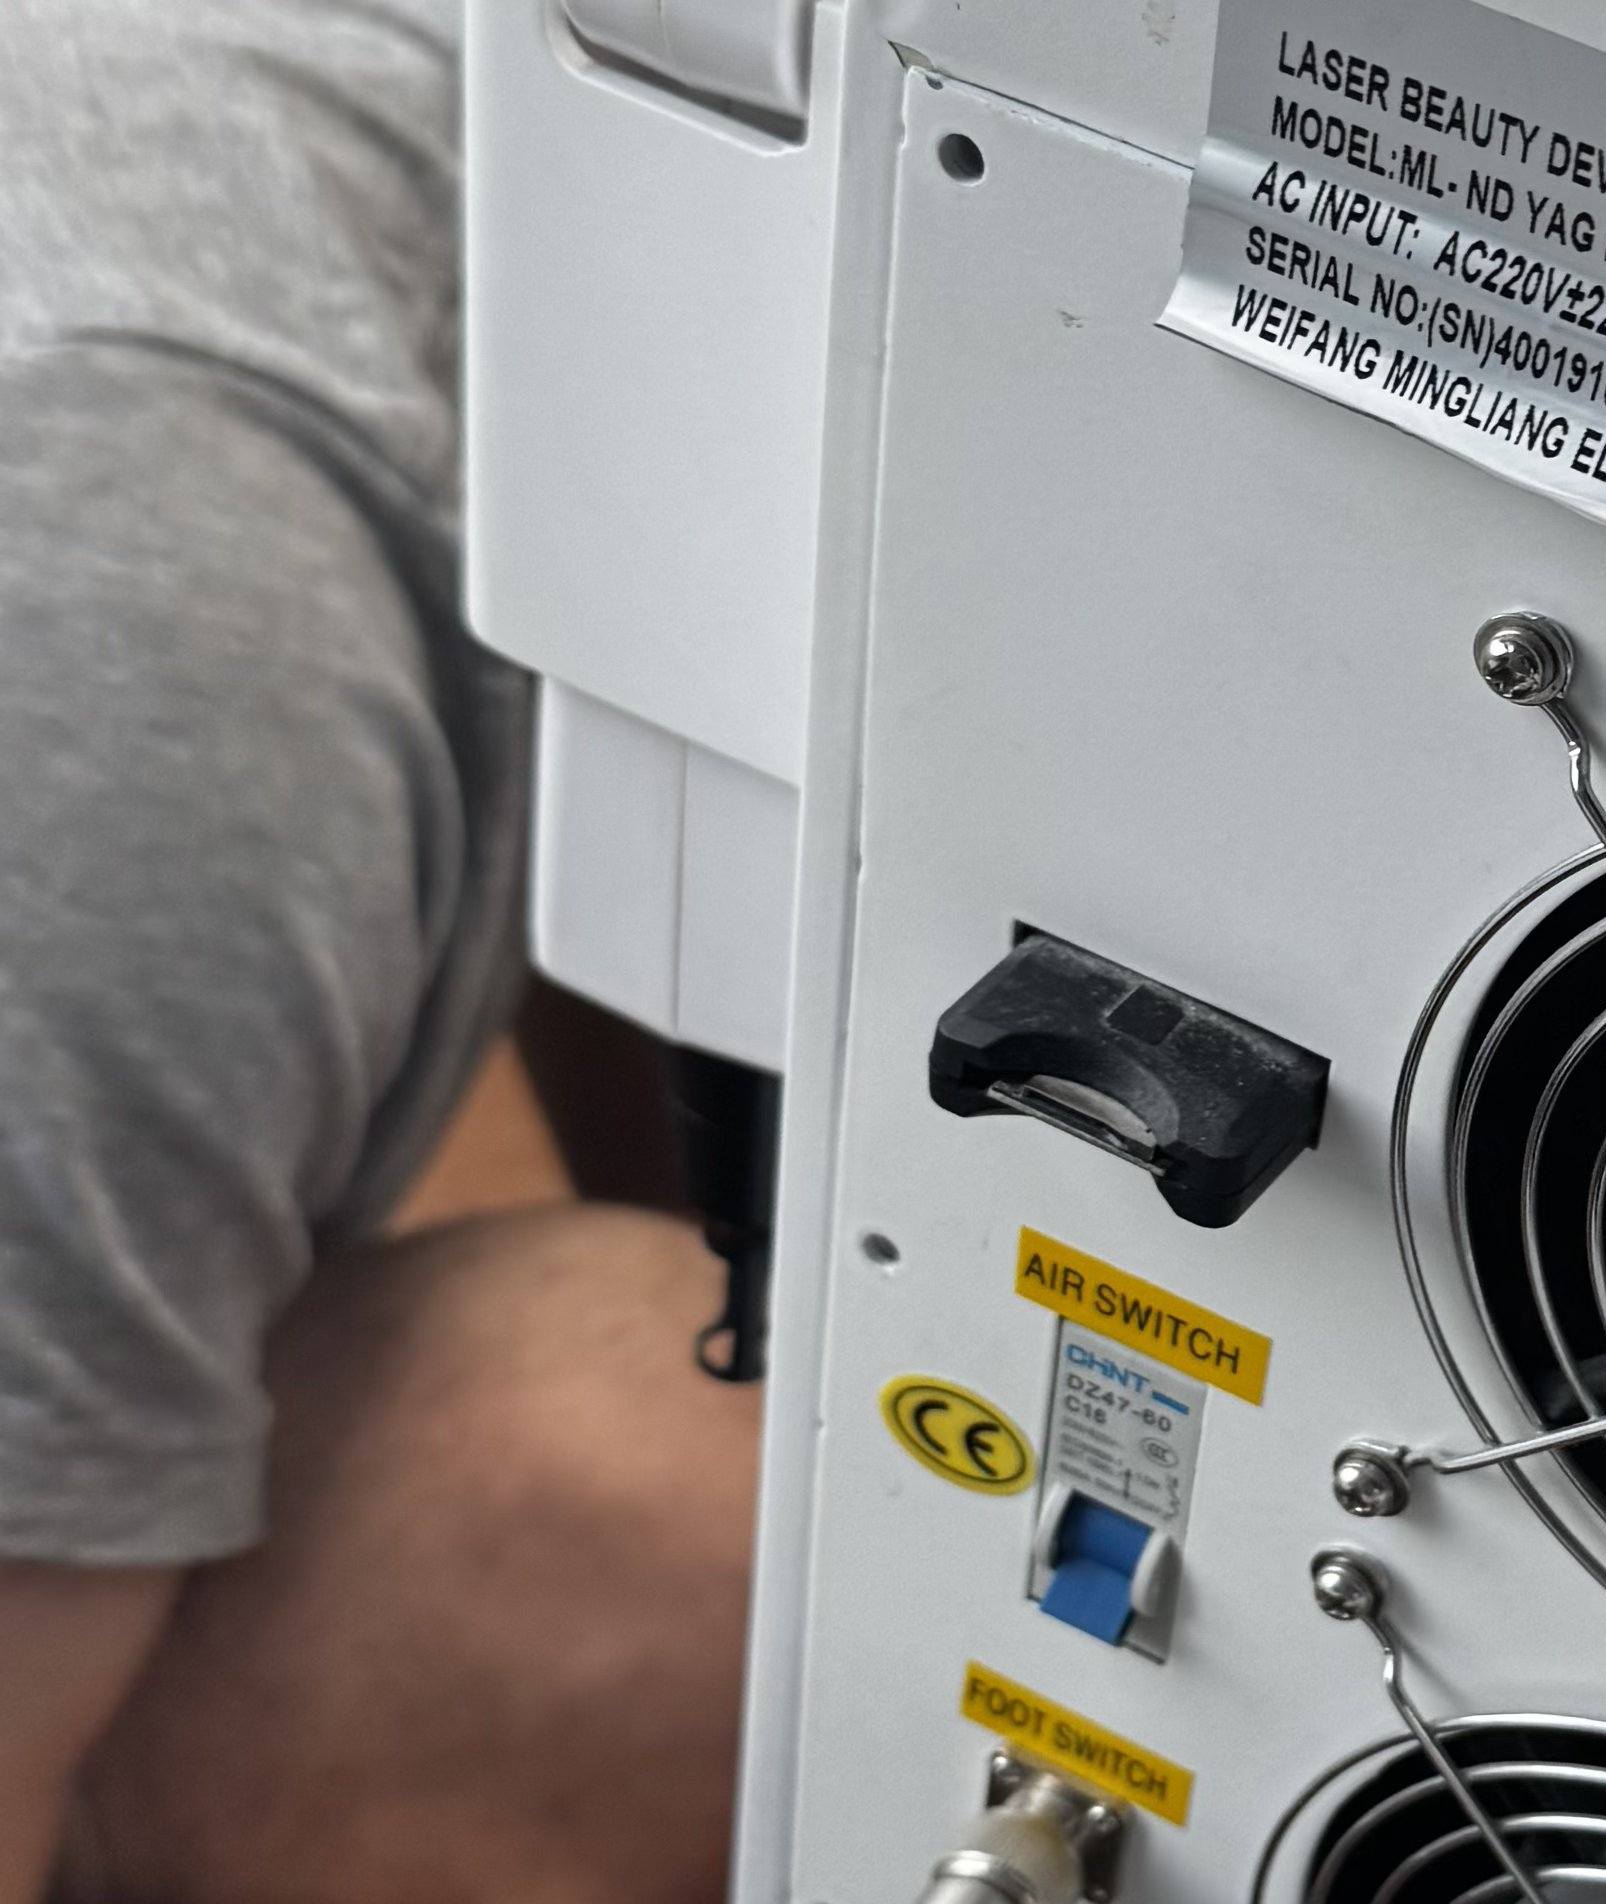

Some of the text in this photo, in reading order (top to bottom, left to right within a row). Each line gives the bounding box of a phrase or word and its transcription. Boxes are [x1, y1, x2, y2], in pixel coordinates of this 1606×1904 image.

[1278, 30, 1390, 112] LASER
[1400, 76, 1540, 164] BEAUTY
[1251, 160, 1306, 214] AC
[1308, 179, 1420, 260] INPUT:
[1465, 169, 1515, 222] ND
[1527, 190, 1596, 253] YAG
[1245, 225, 1360, 307] SERIAL
[1231, 283, 1381, 380] WEIFANG
[1382, 349, 1570, 459] MINGLIANG
[1023, 1252, 1241, 1375] AIR SWITCH
[913, 1399, 1001, 1478] CE
[968, 1677, 1168, 1801] FOOT SWITCH
